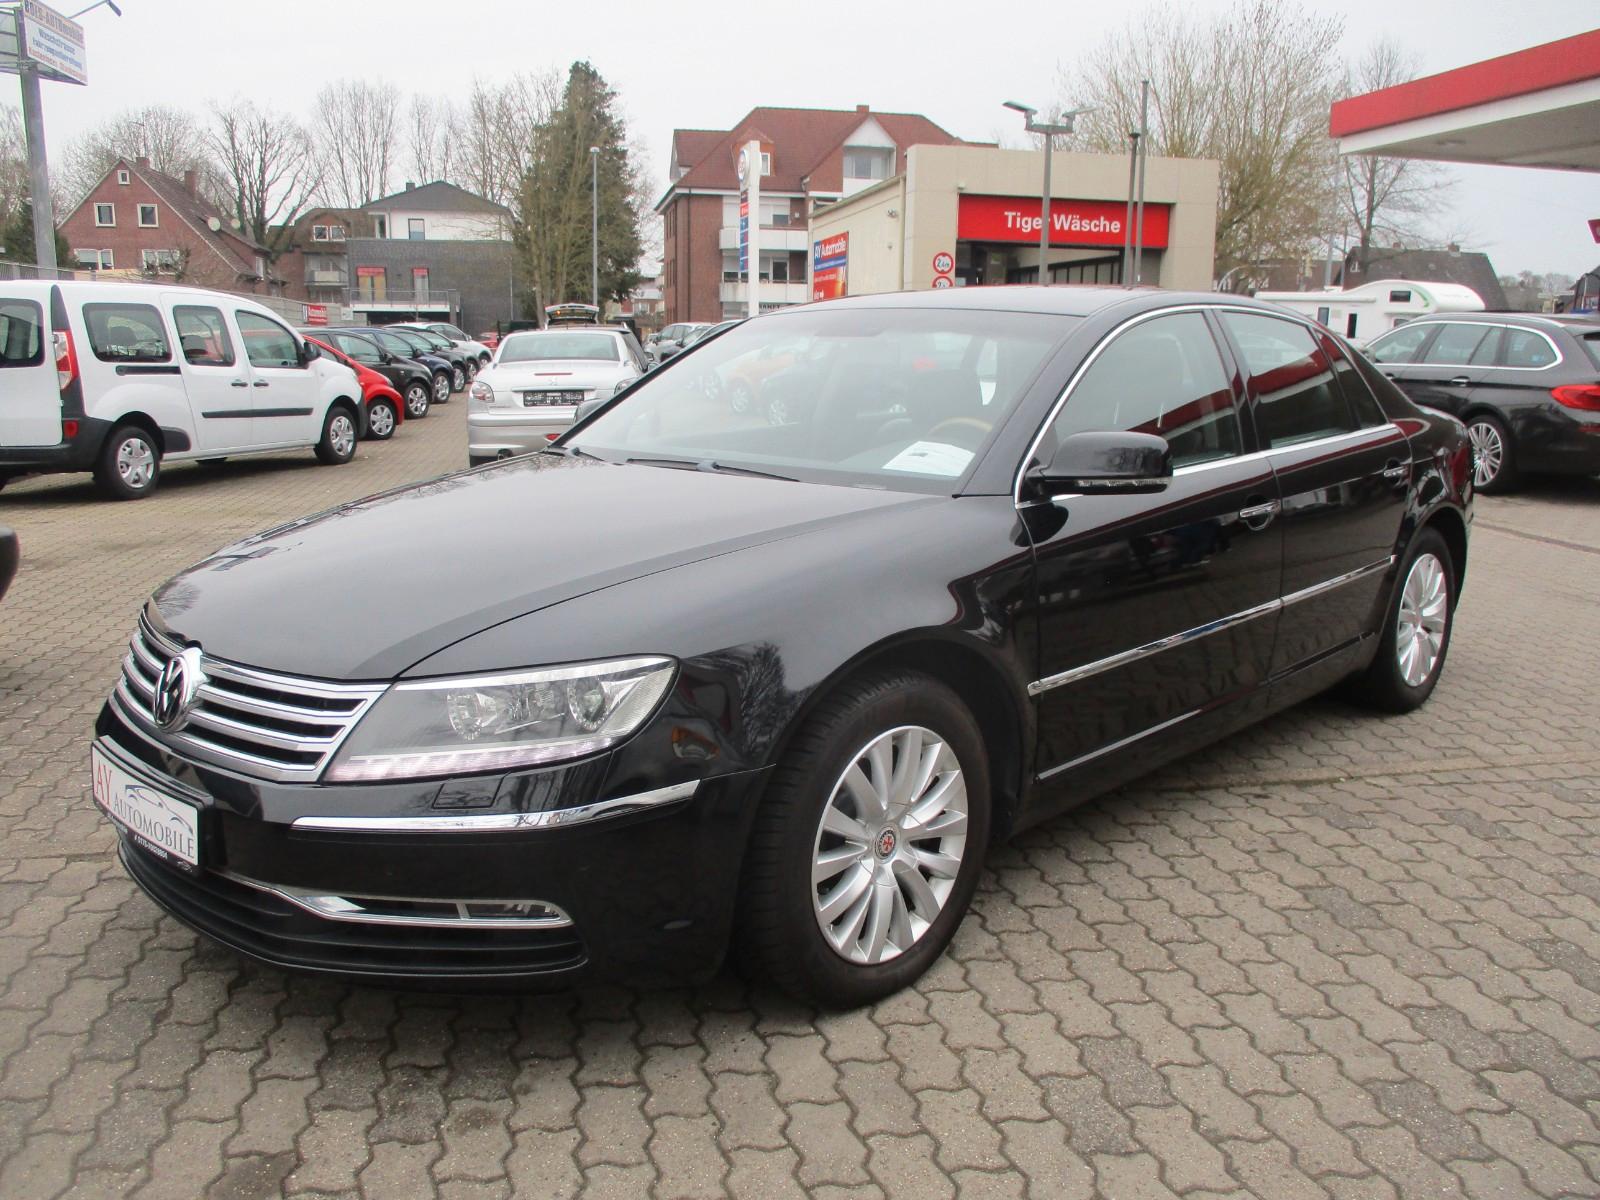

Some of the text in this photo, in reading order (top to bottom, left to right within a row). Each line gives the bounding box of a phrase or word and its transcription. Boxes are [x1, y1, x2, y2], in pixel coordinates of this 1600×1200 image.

[1004, 211, 1121, 234] Tige Wäsche
[96, 759, 113, 807] AY
[113, 793, 195, 858] AUTOMOBILE
